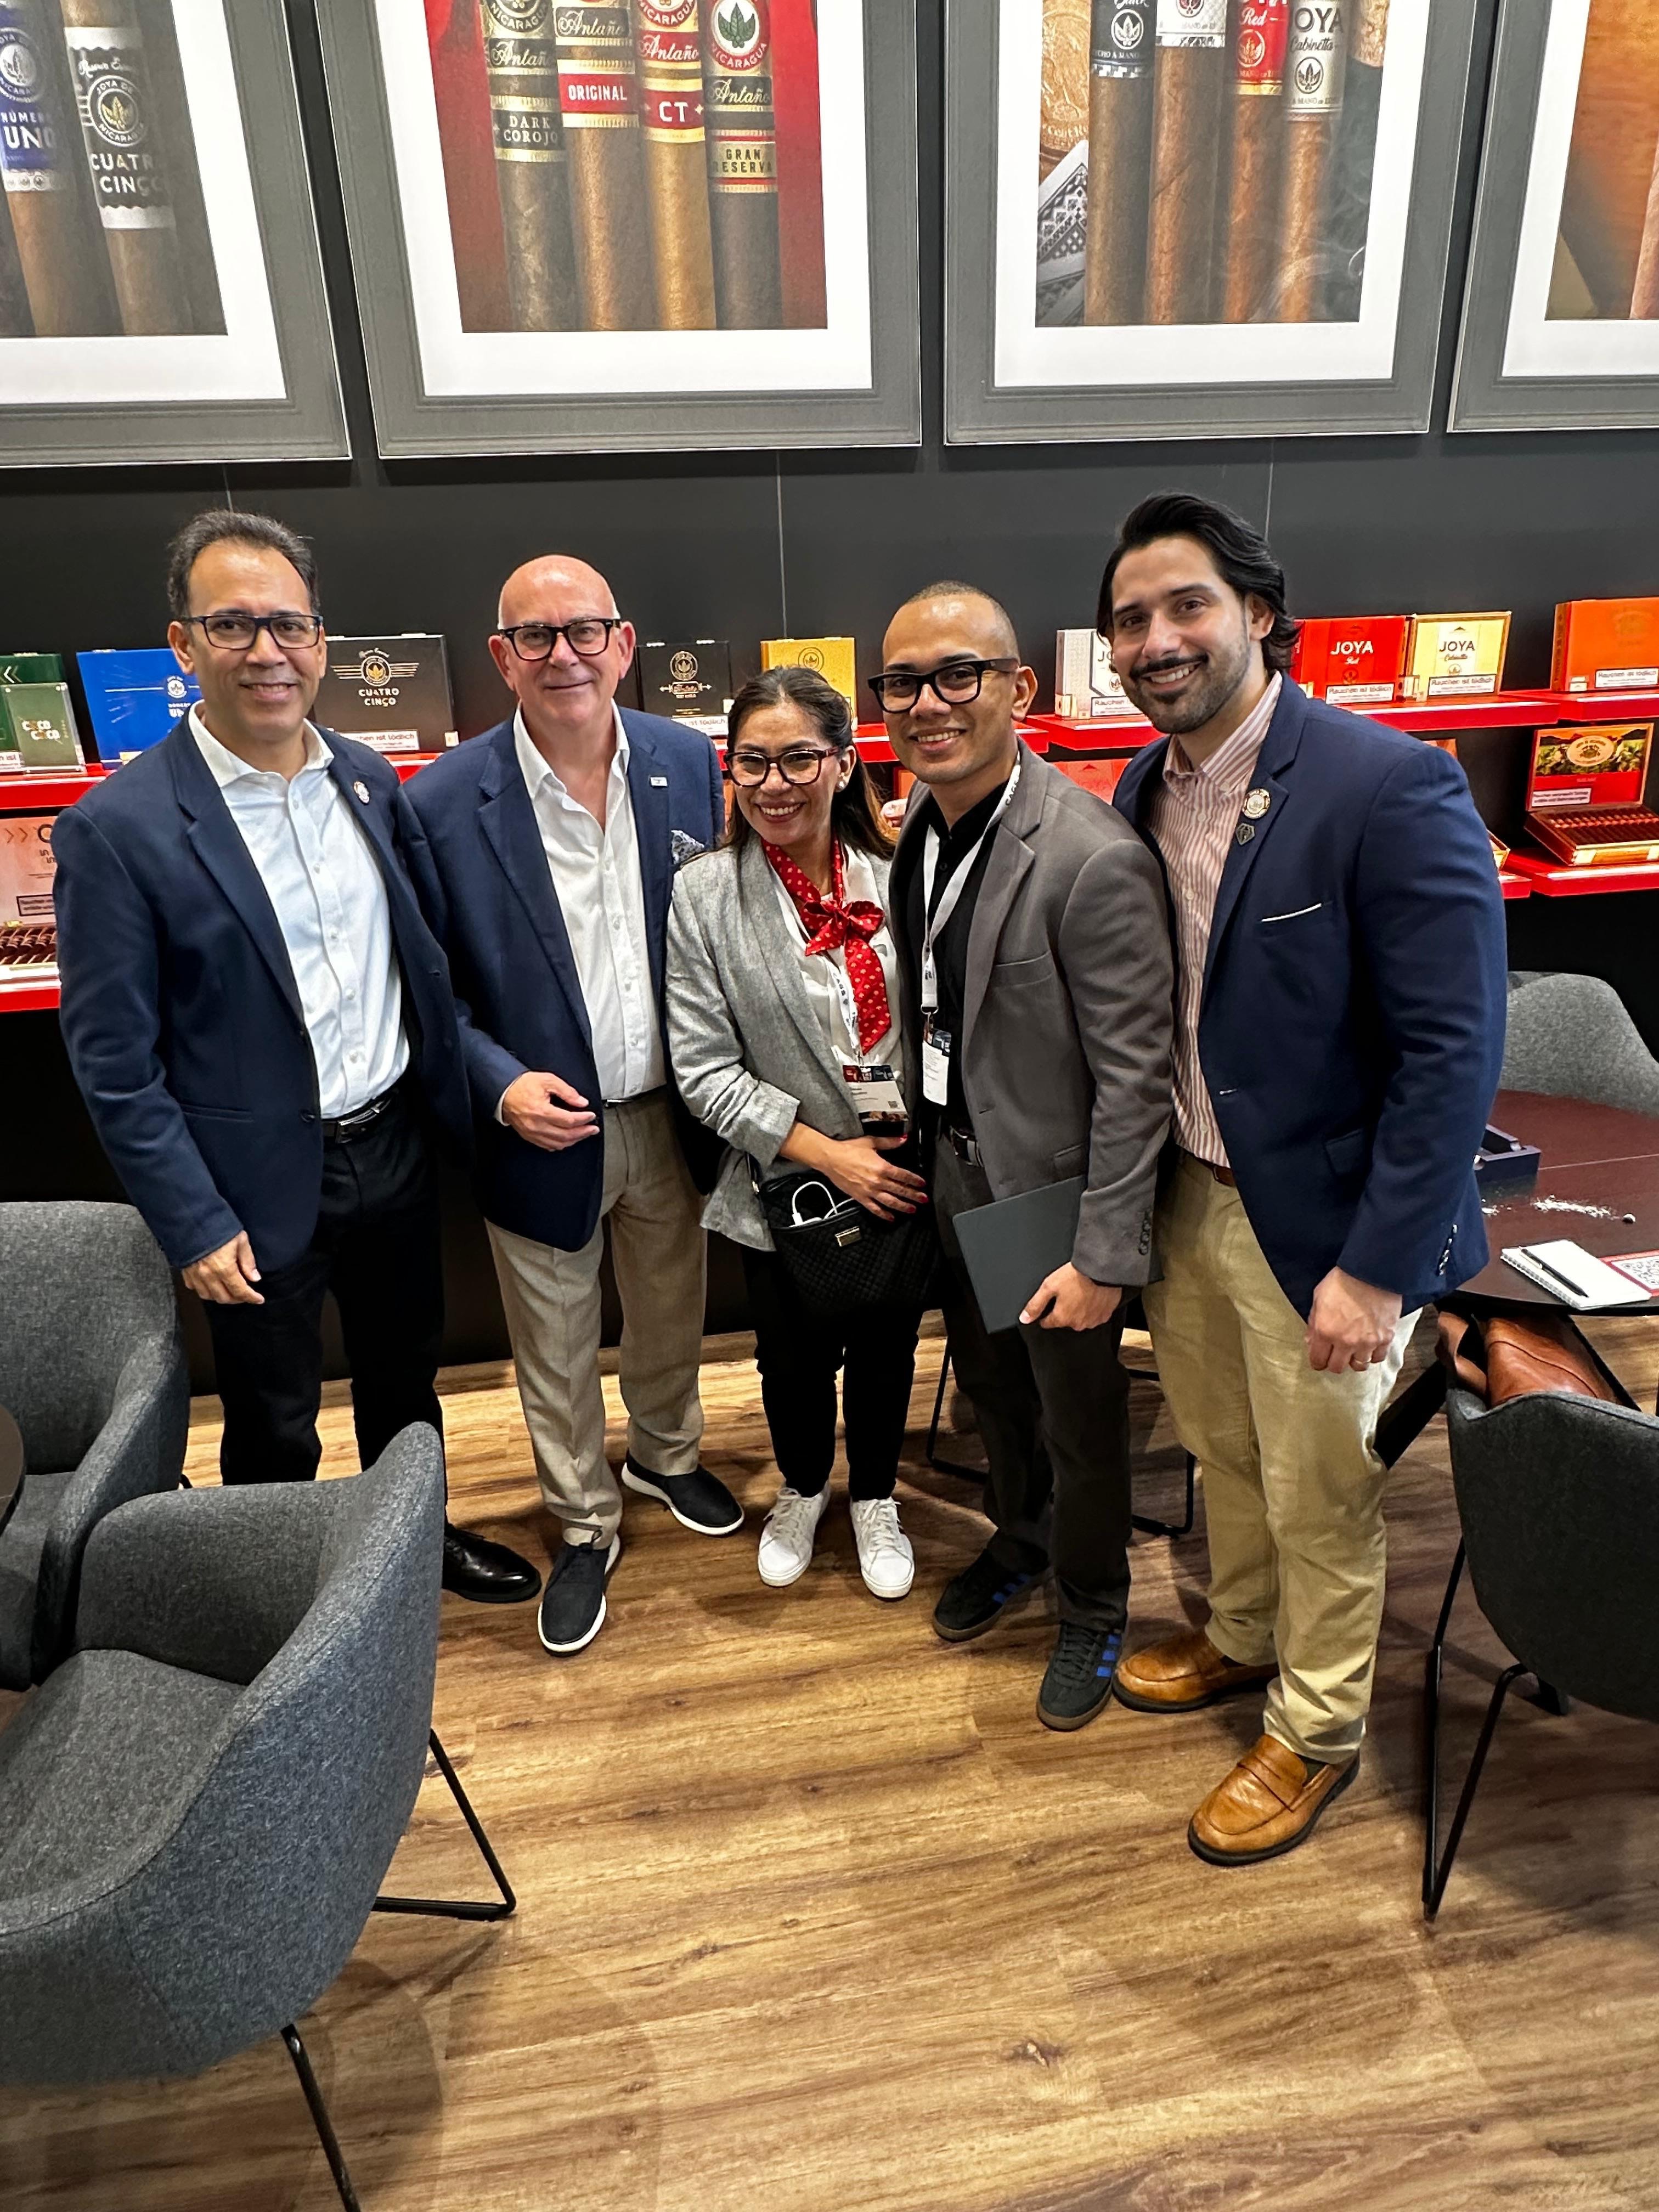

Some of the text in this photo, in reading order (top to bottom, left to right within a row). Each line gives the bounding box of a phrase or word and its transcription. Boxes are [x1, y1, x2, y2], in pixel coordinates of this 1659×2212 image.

[1240, 7, 1267, 25] Red
[1295, 8, 1343, 32] OYA
[489, 40, 548, 66] Antañ
[640, 35, 699, 60] Antaño
[568, 84, 628, 101] ORIGINAL
[659, 101, 689, 122] CT
[509, 115, 550, 129] DARK
[4, 126, 55, 149] UNO
[504, 130, 558, 145] COROJO
[91, 154, 154, 172] CUATR
[726, 149, 760, 160] GRAN
[1330, 641, 1374, 654] JOYA
[1439, 641, 1475, 652] JOYA
[359, 688, 399, 697] CUATRO
[364, 697, 396, 707] CINCO
